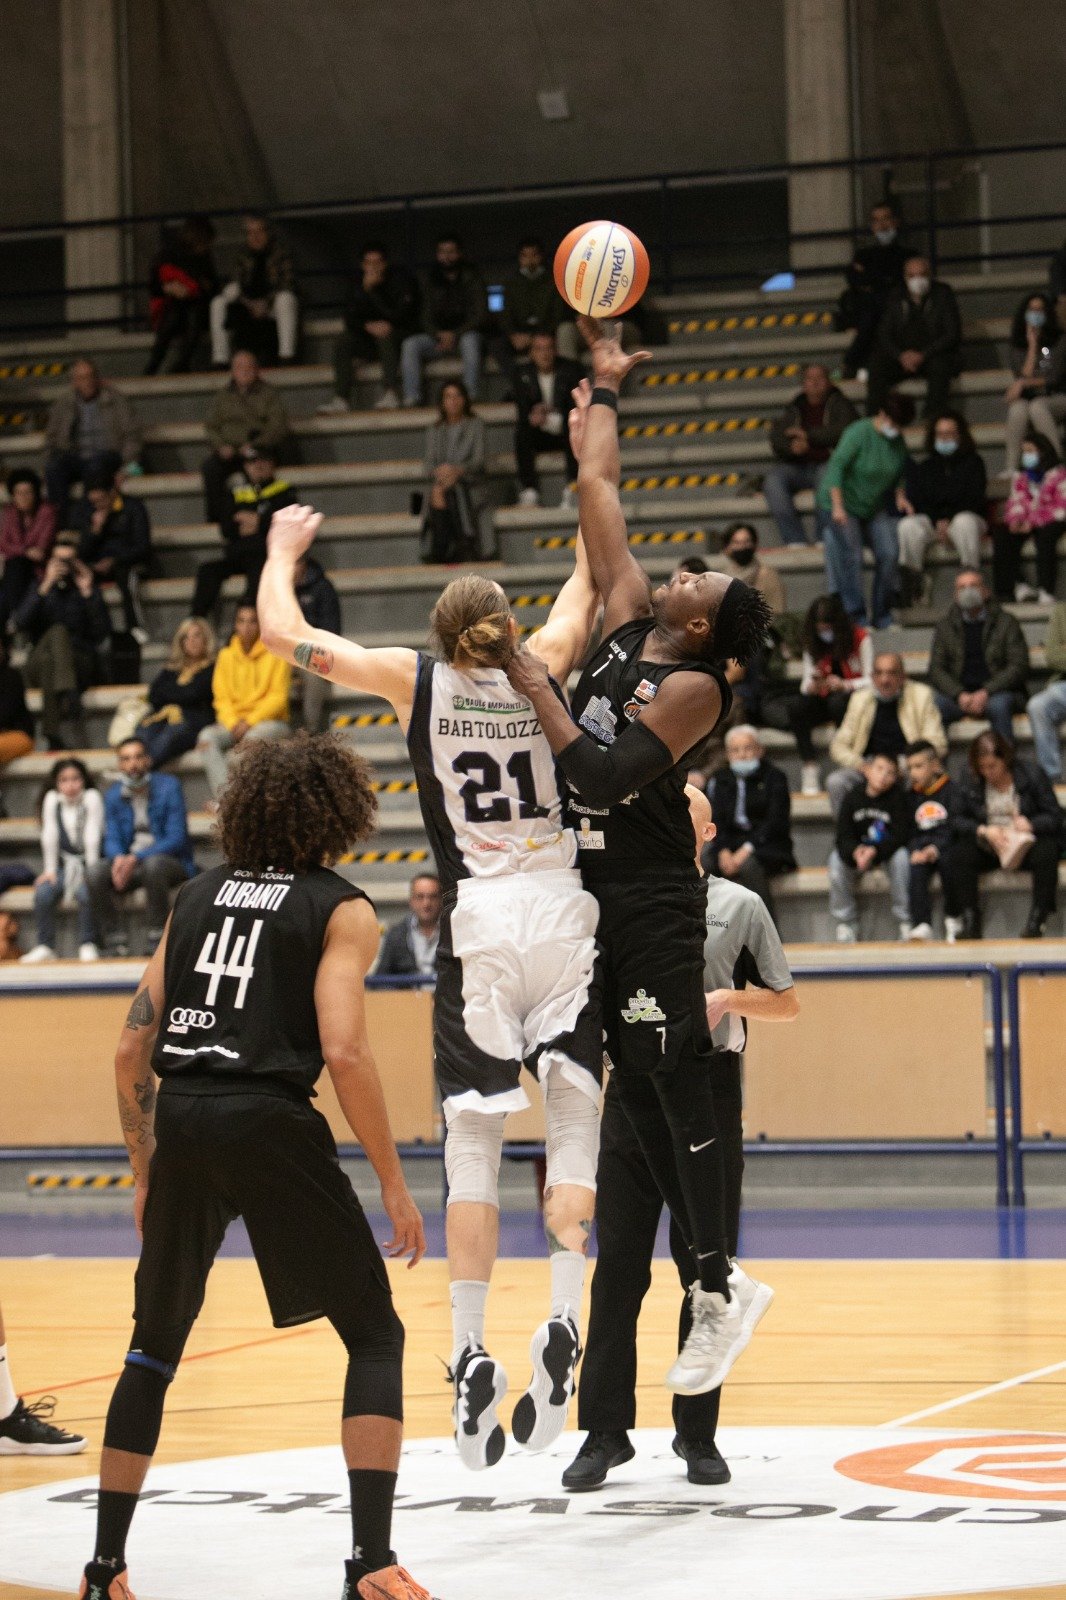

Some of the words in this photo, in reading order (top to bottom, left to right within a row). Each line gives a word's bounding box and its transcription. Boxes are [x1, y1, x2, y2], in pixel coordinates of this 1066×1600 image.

[598, 245, 626, 308] SPALDING
[592, 653, 614, 677] 7
[452, 750, 551, 823] 21
[194, 916, 264, 1009] 44
[655, 1026, 667, 1055] 7
